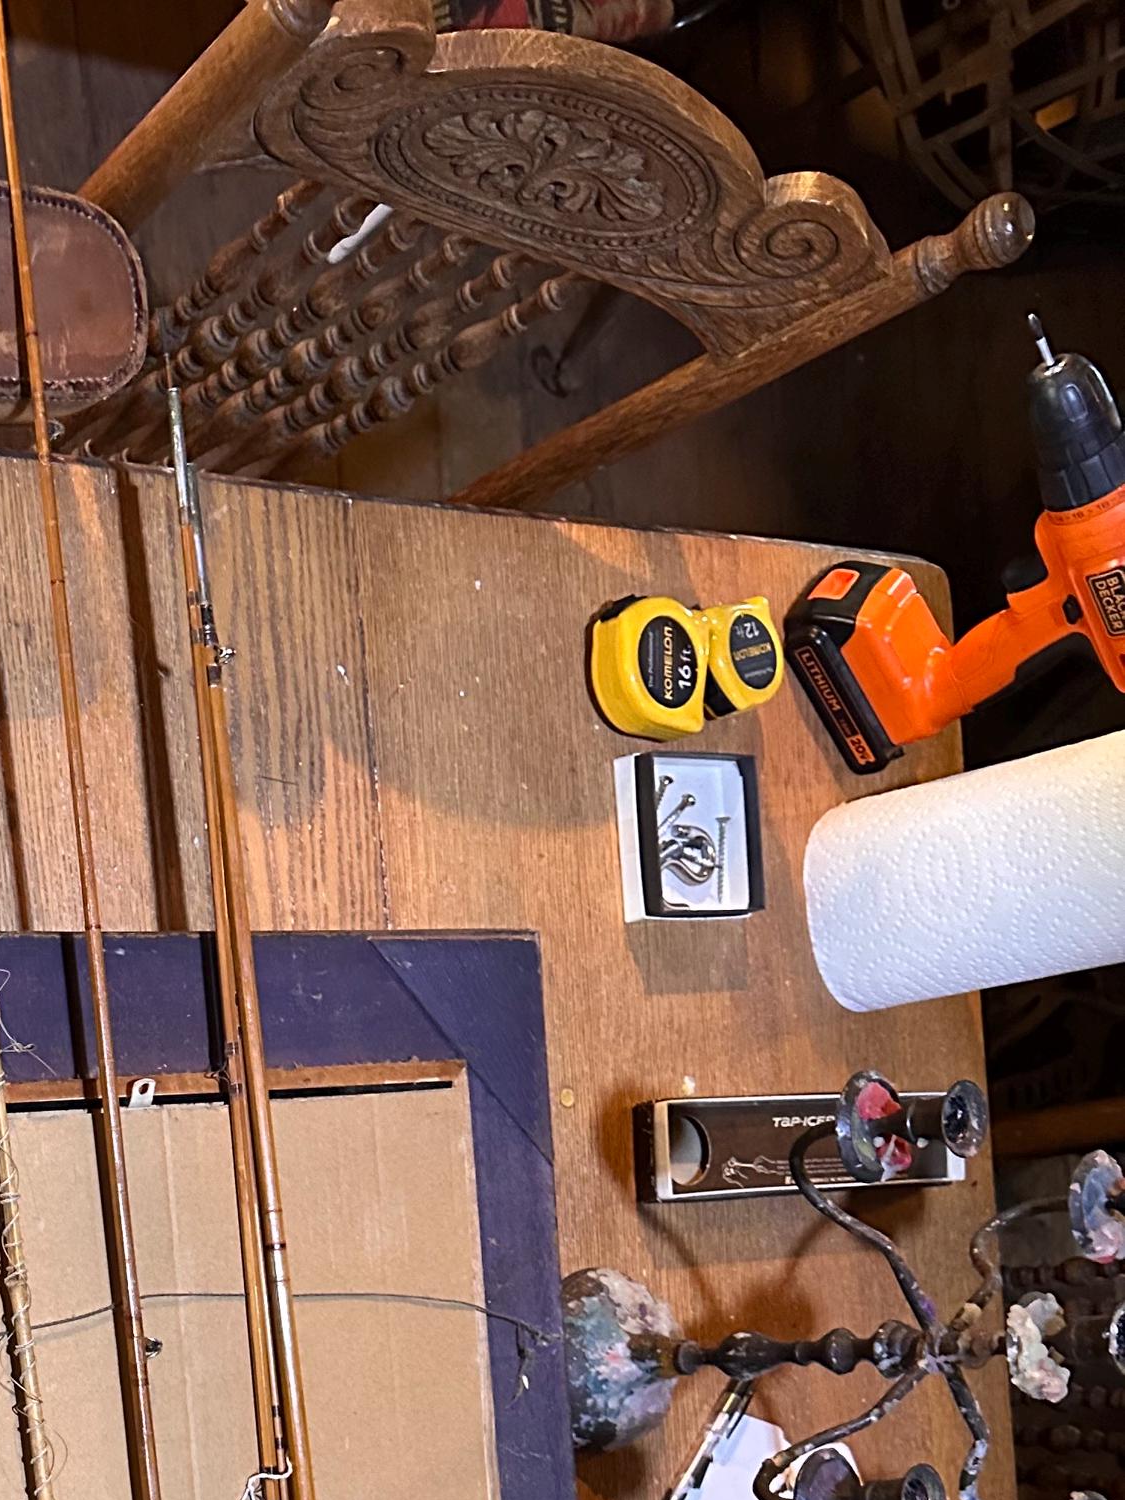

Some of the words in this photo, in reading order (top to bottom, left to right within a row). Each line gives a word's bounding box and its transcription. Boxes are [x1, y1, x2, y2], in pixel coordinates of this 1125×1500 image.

[744, 621, 760, 639] 12
[1095, 580, 1124, 630] DECKER
[663, 625, 674, 701] KOMELON
[678, 664, 693, 691] 16
[800, 651, 842, 712] LITHIUM
